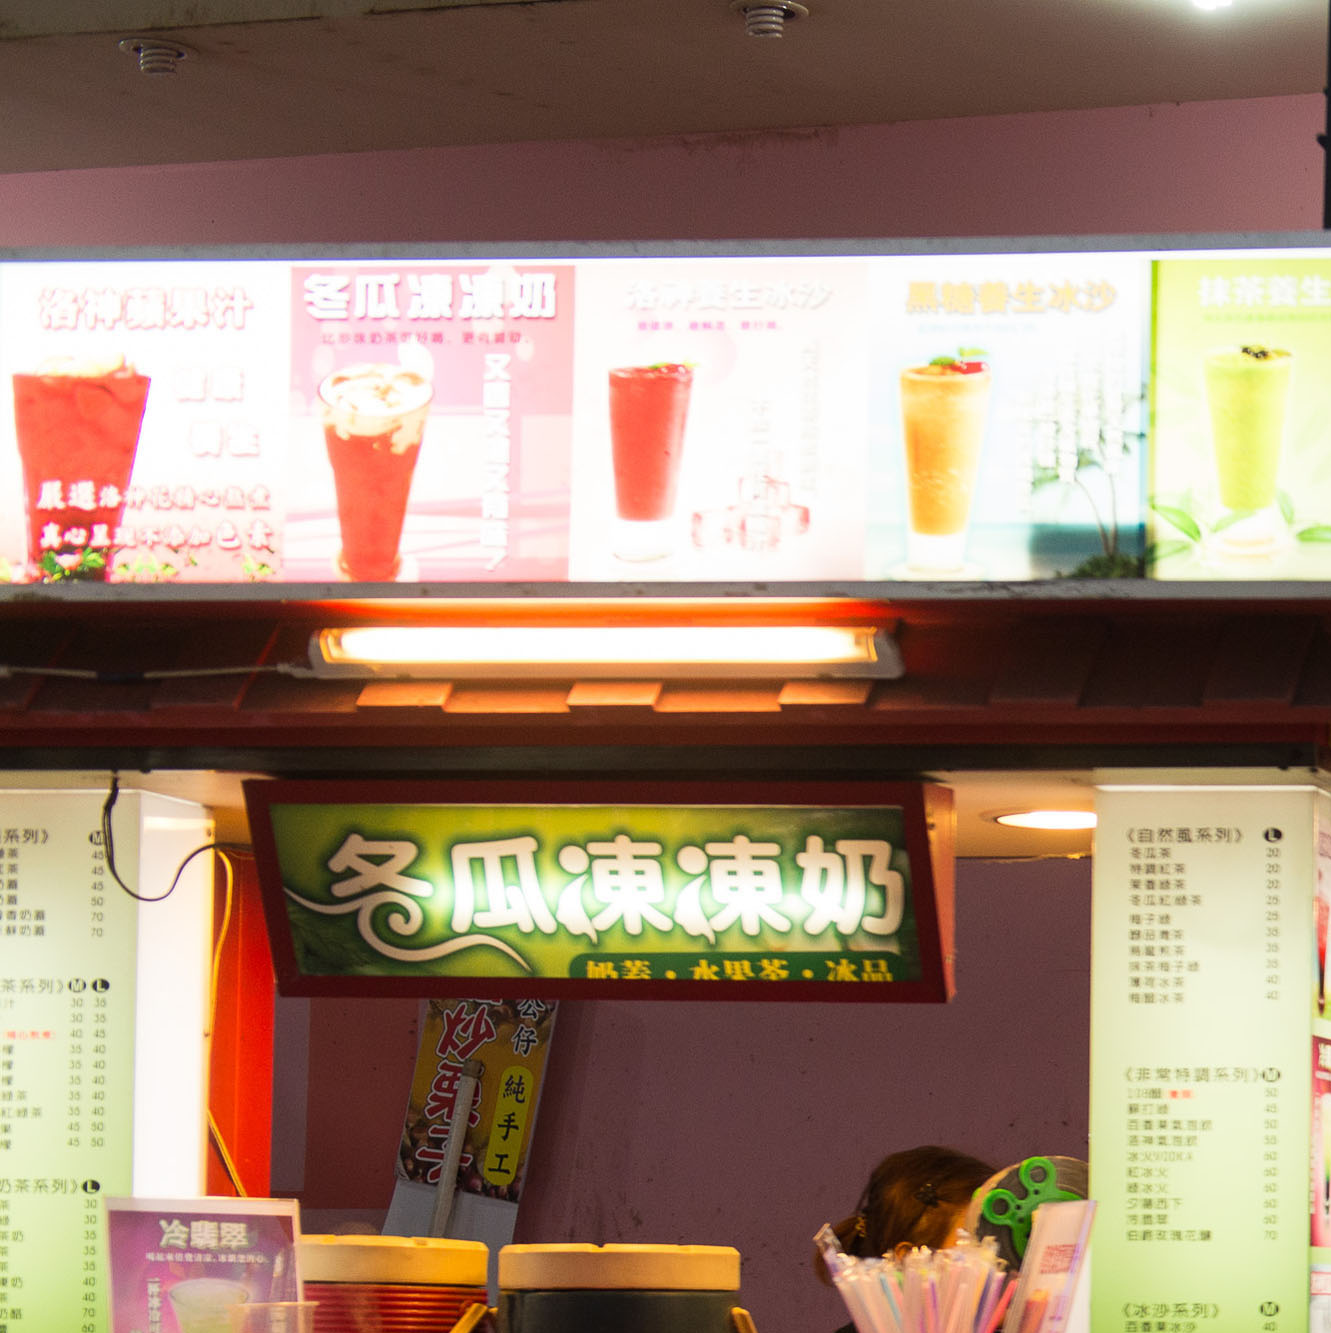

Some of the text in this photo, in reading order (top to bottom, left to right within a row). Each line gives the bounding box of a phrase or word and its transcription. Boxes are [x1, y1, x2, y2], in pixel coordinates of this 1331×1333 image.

[327, 833, 903, 946] 冬瓜凍凍奶
[487, 1074, 526, 1175] 純手工
